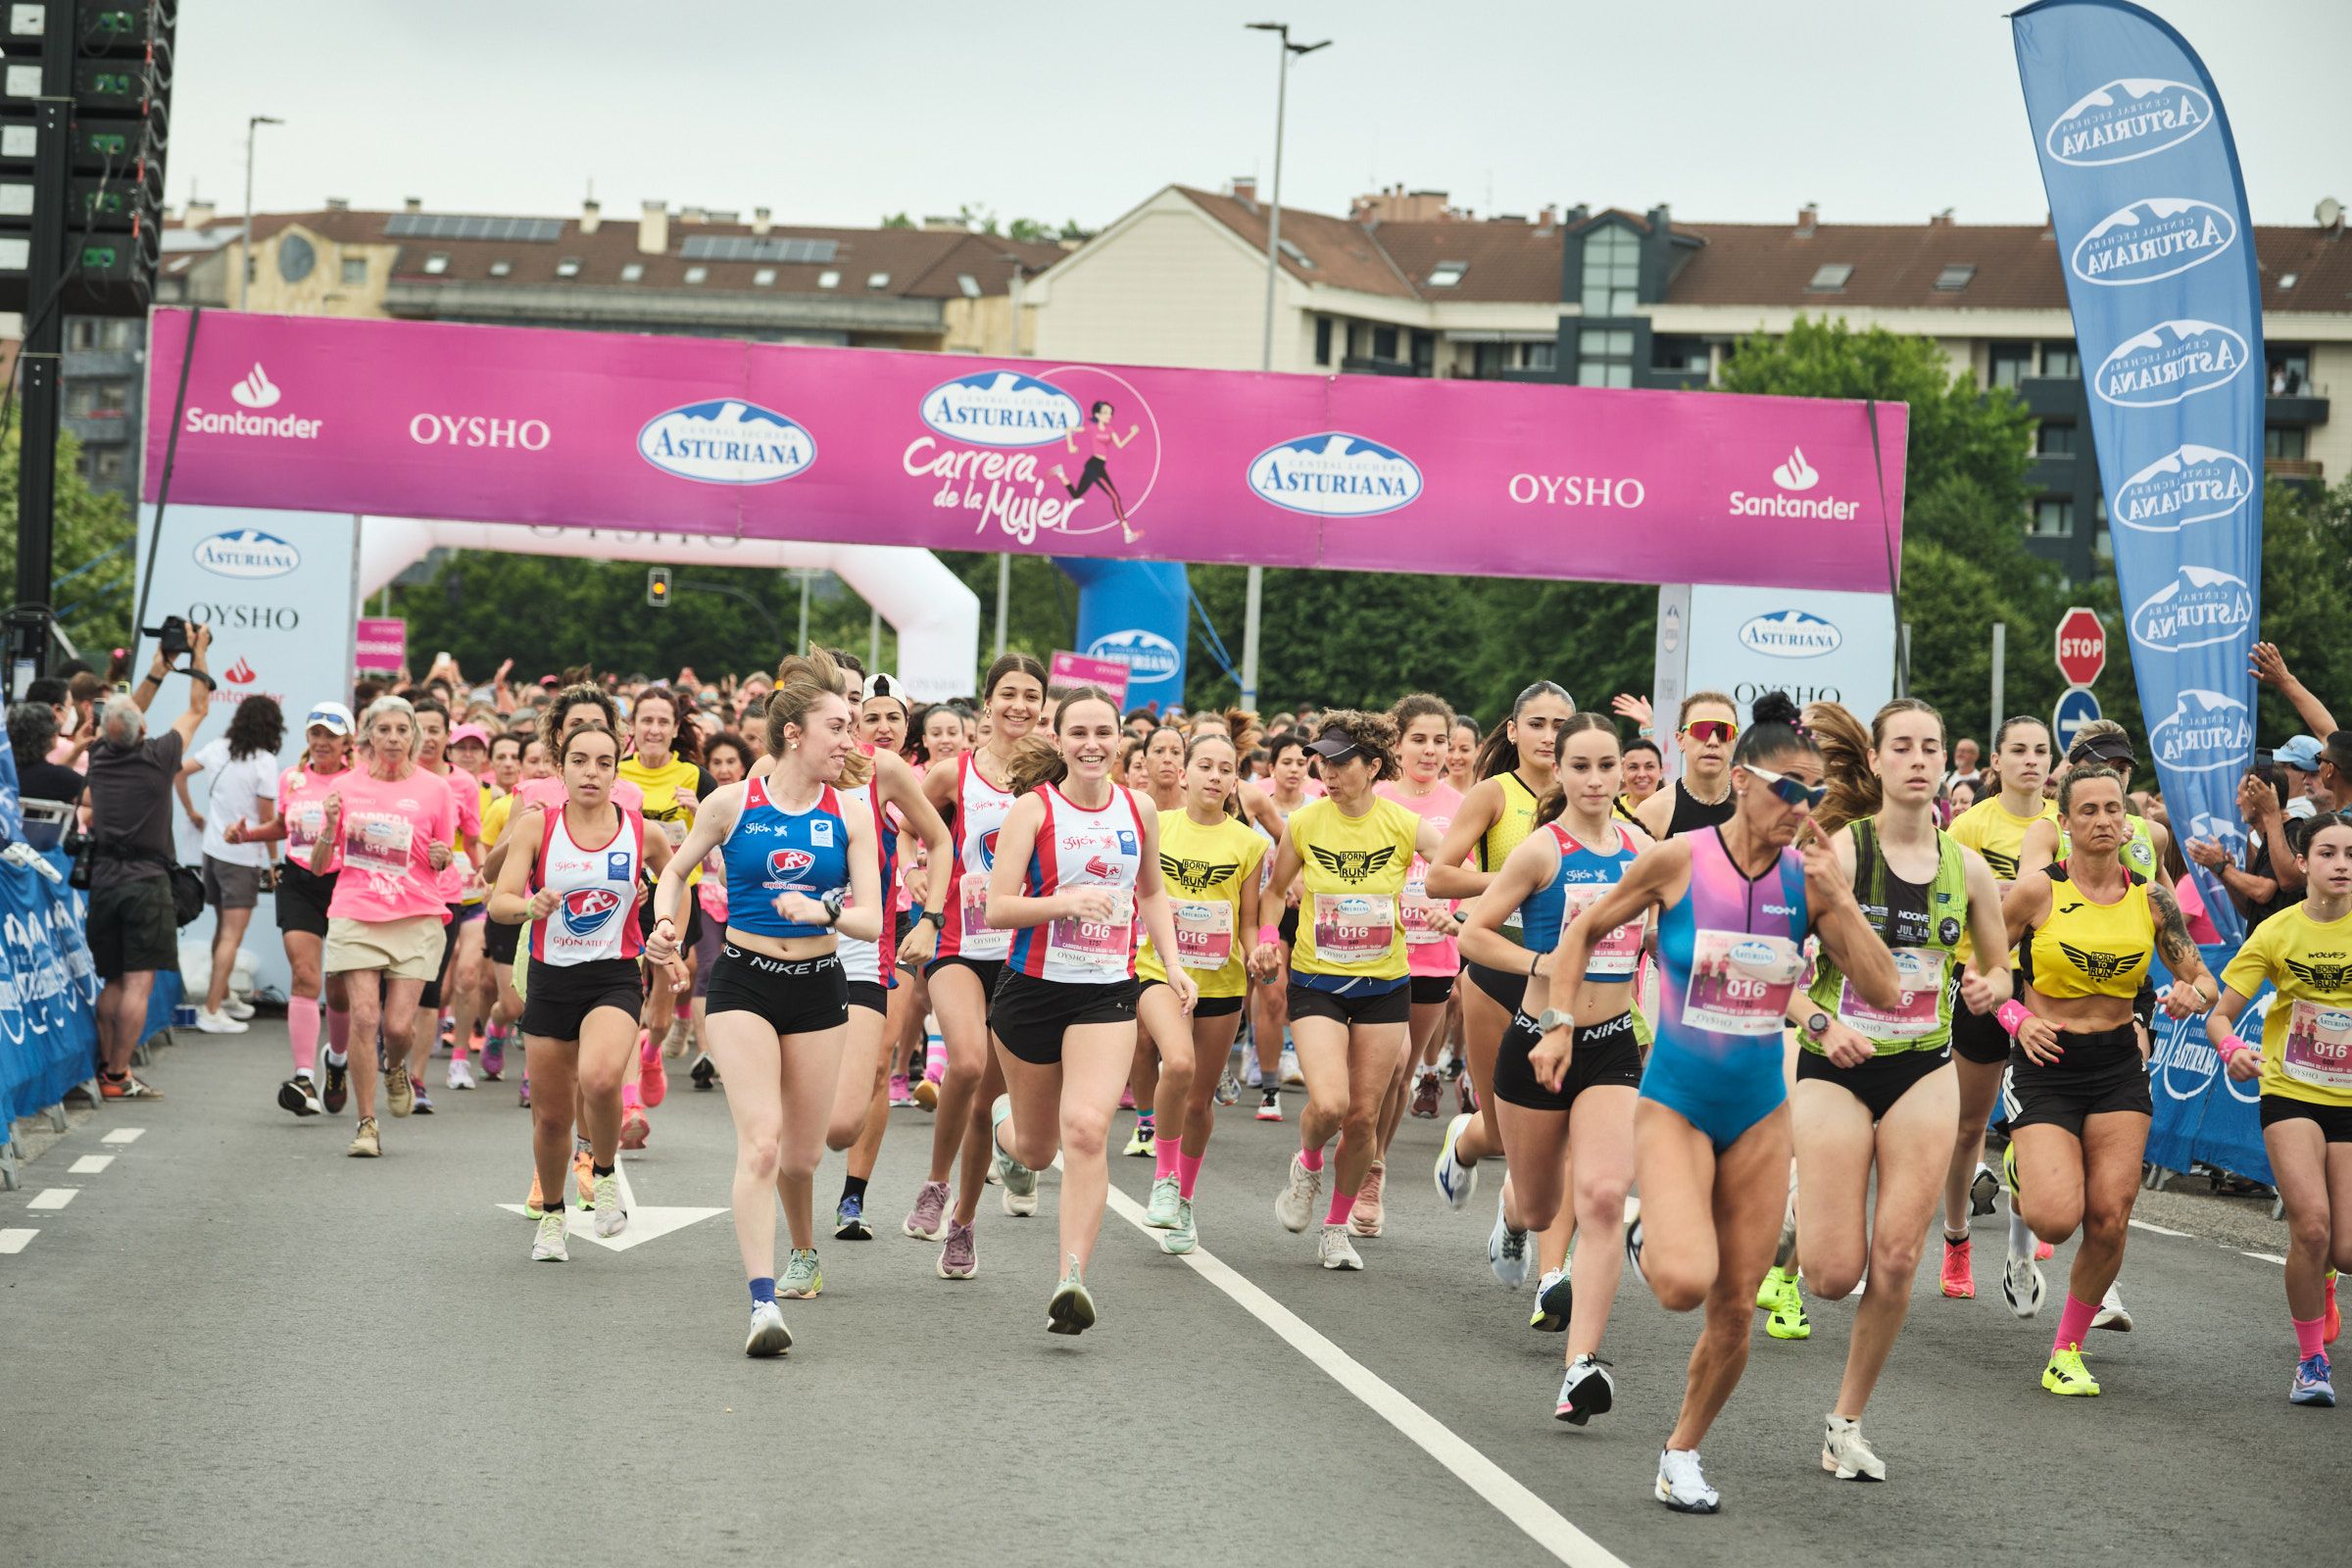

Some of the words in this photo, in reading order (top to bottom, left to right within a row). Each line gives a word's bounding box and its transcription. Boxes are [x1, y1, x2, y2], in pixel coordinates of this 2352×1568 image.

[934, 396, 1067, 429] ASTURIANA
[185, 406, 322, 440] Santander
[410, 413, 551, 451] OYSHO
[654, 427, 800, 465] ASTURIANA
[903, 436, 1038, 483] Carrera
[1262, 461, 1407, 496] ASTURIANA
[933, 479, 959, 508] de
[963, 479, 983, 510] la
[1509, 473, 1645, 509] OYSHO
[976, 479, 1085, 546] Mujer
[1730, 491, 1860, 520] Santander
[202, 546, 292, 568] ASTURIANA
[187, 602, 299, 631] OYSHO
[1747, 626, 1834, 648] ASTURIANA
[2062, 638, 2102, 658] STOP
[1062, 835, 1097, 851] gijón
[1342, 853, 1365, 861] BORN
[1184, 861, 1208, 871] BORN
[1342, 868, 1366, 877] RUN
[1183, 876, 1206, 887] RUN
[1897, 909, 1931, 923] NOONE
[1081, 922, 1111, 939] 016
[1178, 932, 1208, 945] 016
[1339, 926, 1369, 939] 016
[1605, 925, 1626, 940] 16
[1896, 924, 1931, 938] JULÁN
[553, 936, 583, 947] GIJÓN
[973, 936, 1001, 945] OYSHO
[1057, 951, 1086, 961] OYSHO
[2092, 954, 2114, 962] BORN
[750, 956, 811, 975] NIKE
[2317, 965, 2338, 974] BORN
[1726, 979, 1767, 998] 016
[1583, 1012, 1633, 1042] NIKE
[1696, 1013, 1733, 1027] OYSHO
[2188, 1027, 2207, 1039] CENTRA
[2169, 1028, 2218, 1076] ASTURIANA
[2314, 1041, 2348, 1058] 016
[2290, 1066, 2319, 1079] OYSHO
